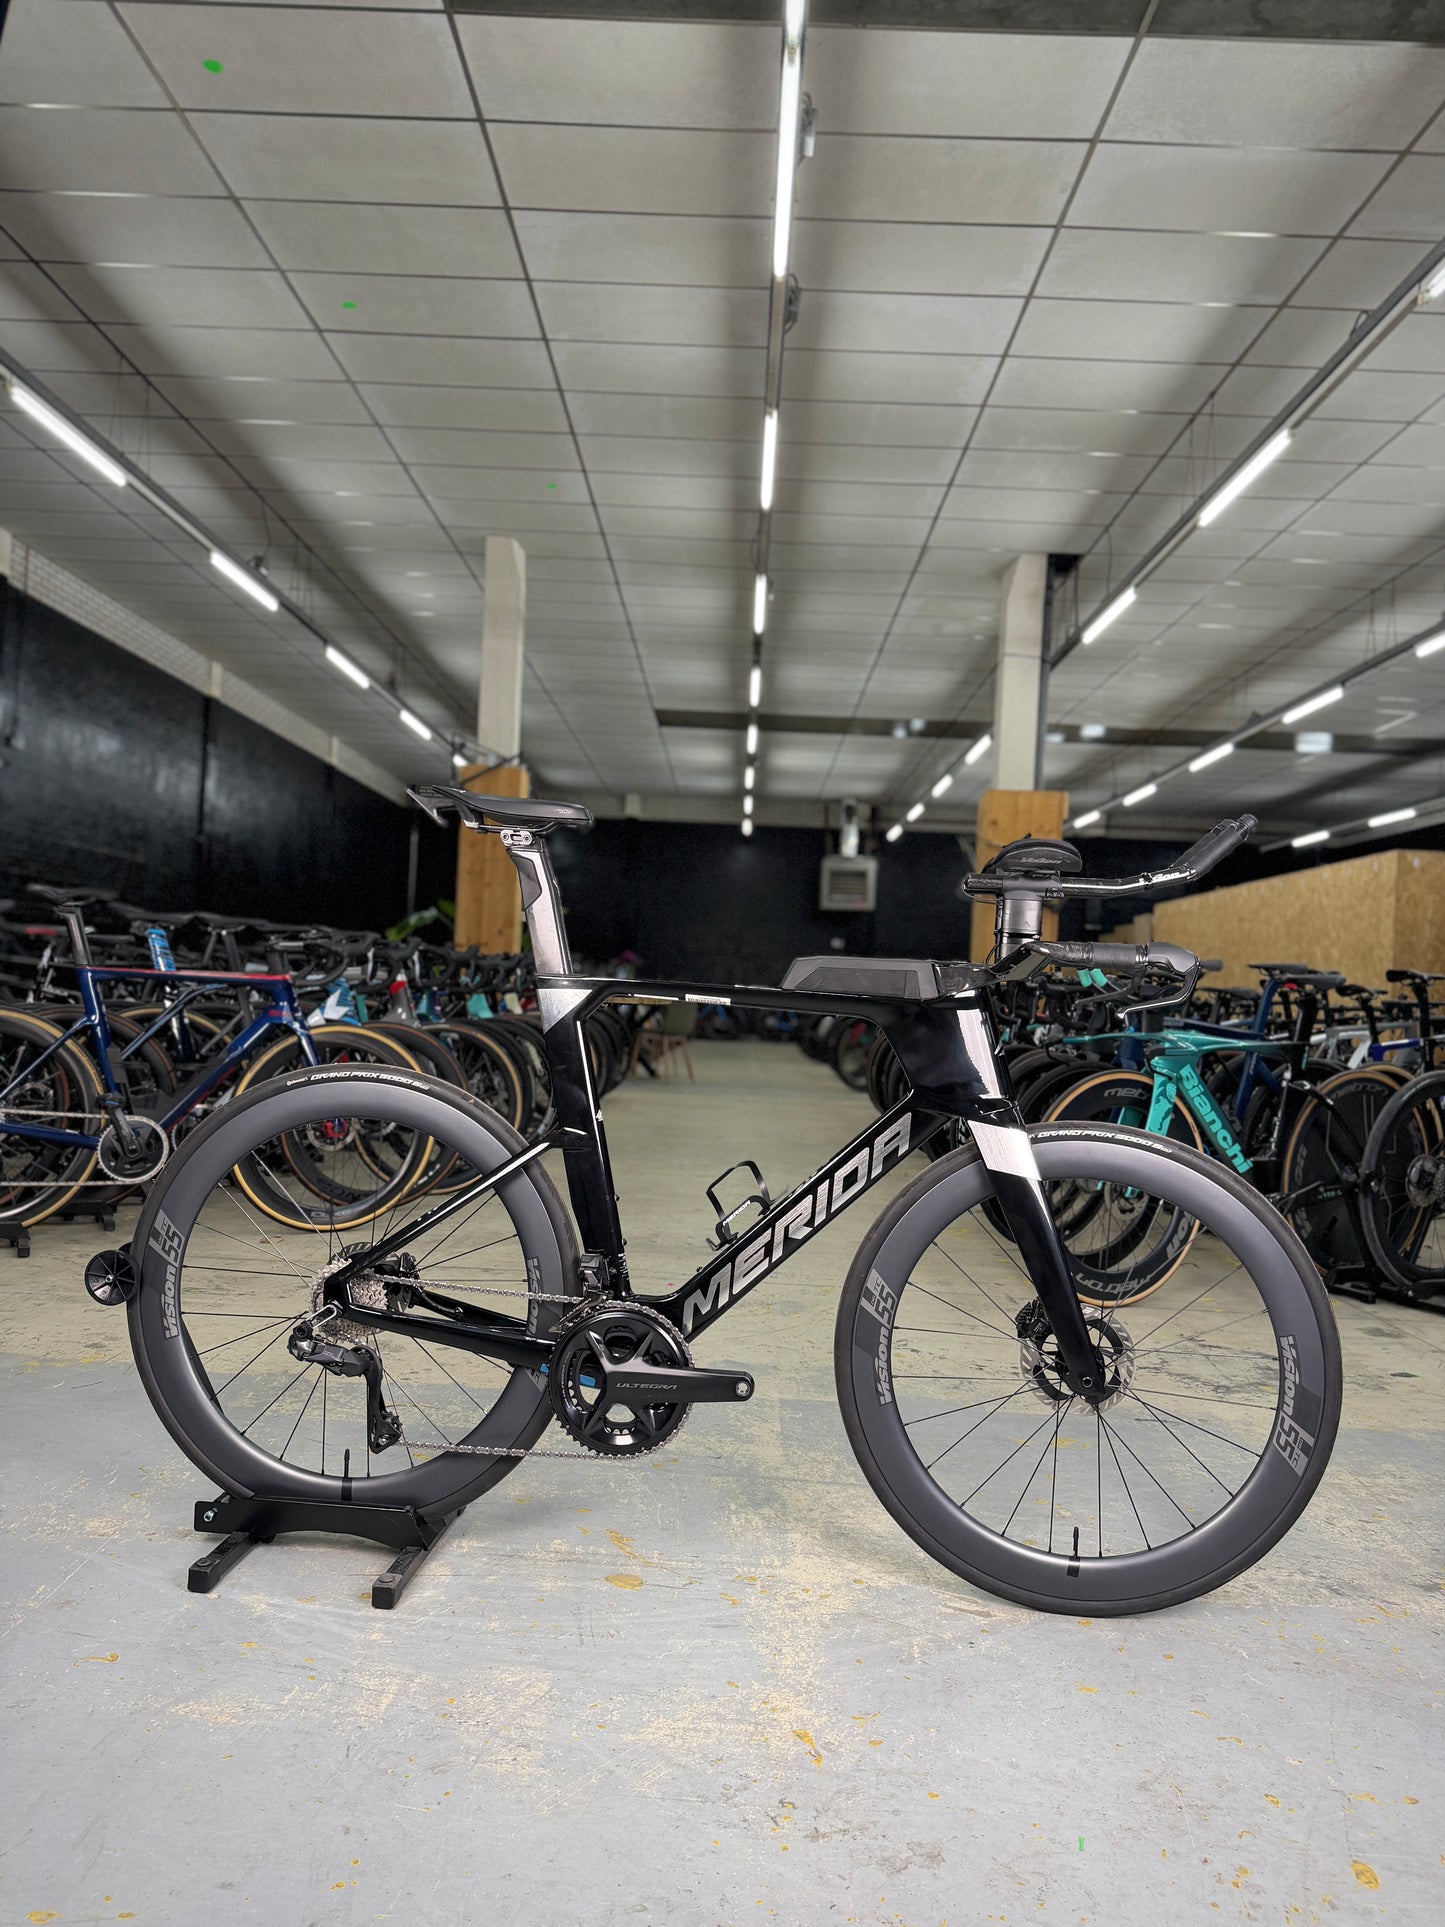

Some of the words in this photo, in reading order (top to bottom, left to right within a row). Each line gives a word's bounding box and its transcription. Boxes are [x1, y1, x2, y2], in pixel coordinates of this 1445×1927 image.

[310, 1071, 351, 1081] GRAND
[350, 1071, 380, 1079] PRIX
[379, 1073, 413, 1085] 5000
[1037, 1129, 1083, 1139] GRAND
[1082, 1130, 1115, 1139] PRIX
[1113, 1133, 1154, 1147] 5000
[1178, 1063, 1254, 1175] Bianchi
[160, 1224, 183, 1264] 55
[681, 1112, 912, 1338] MERIDA
[526, 1257, 541, 1336] Vison
[874, 1283, 895, 1325] 55
[616, 1381, 678, 1391] ULTEGRA
[1276, 1417, 1299, 1460] 55
